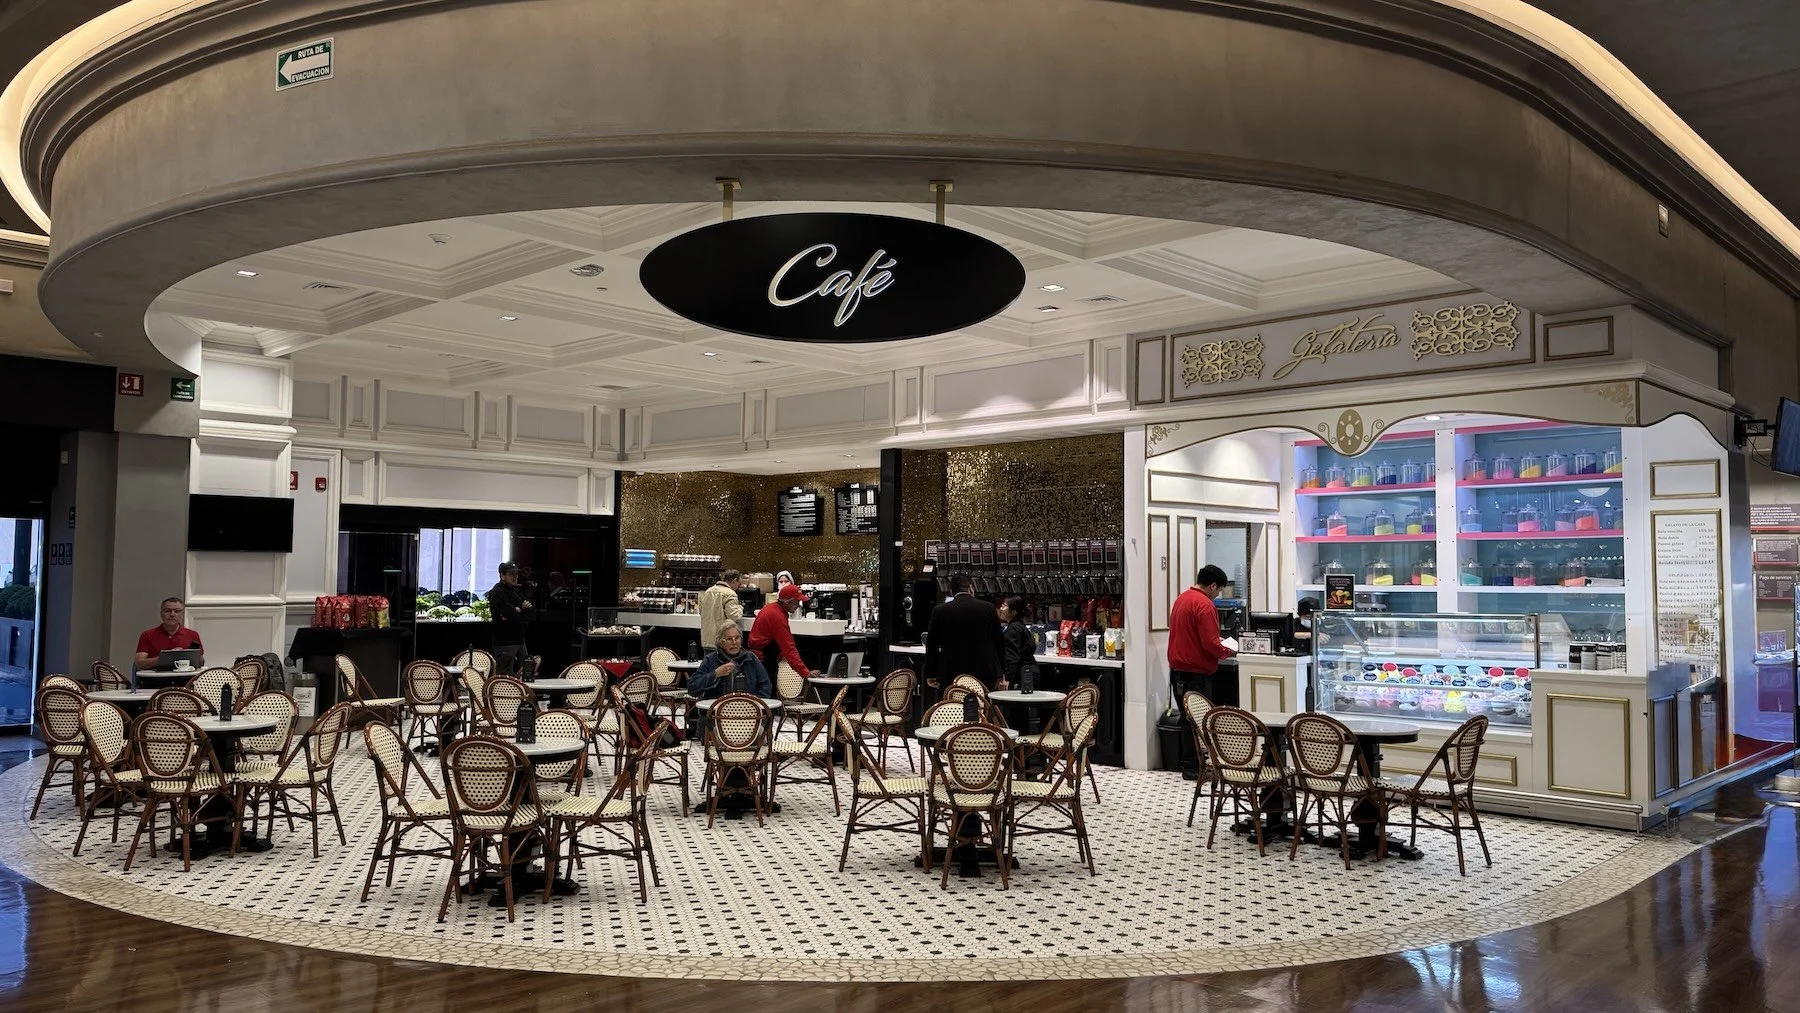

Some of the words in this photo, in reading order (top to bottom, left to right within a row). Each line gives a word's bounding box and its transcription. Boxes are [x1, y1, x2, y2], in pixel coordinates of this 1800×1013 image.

[298, 48, 314, 59] RUTA
[315, 45, 324, 54] DE
[767, 243, 897, 327] Café
